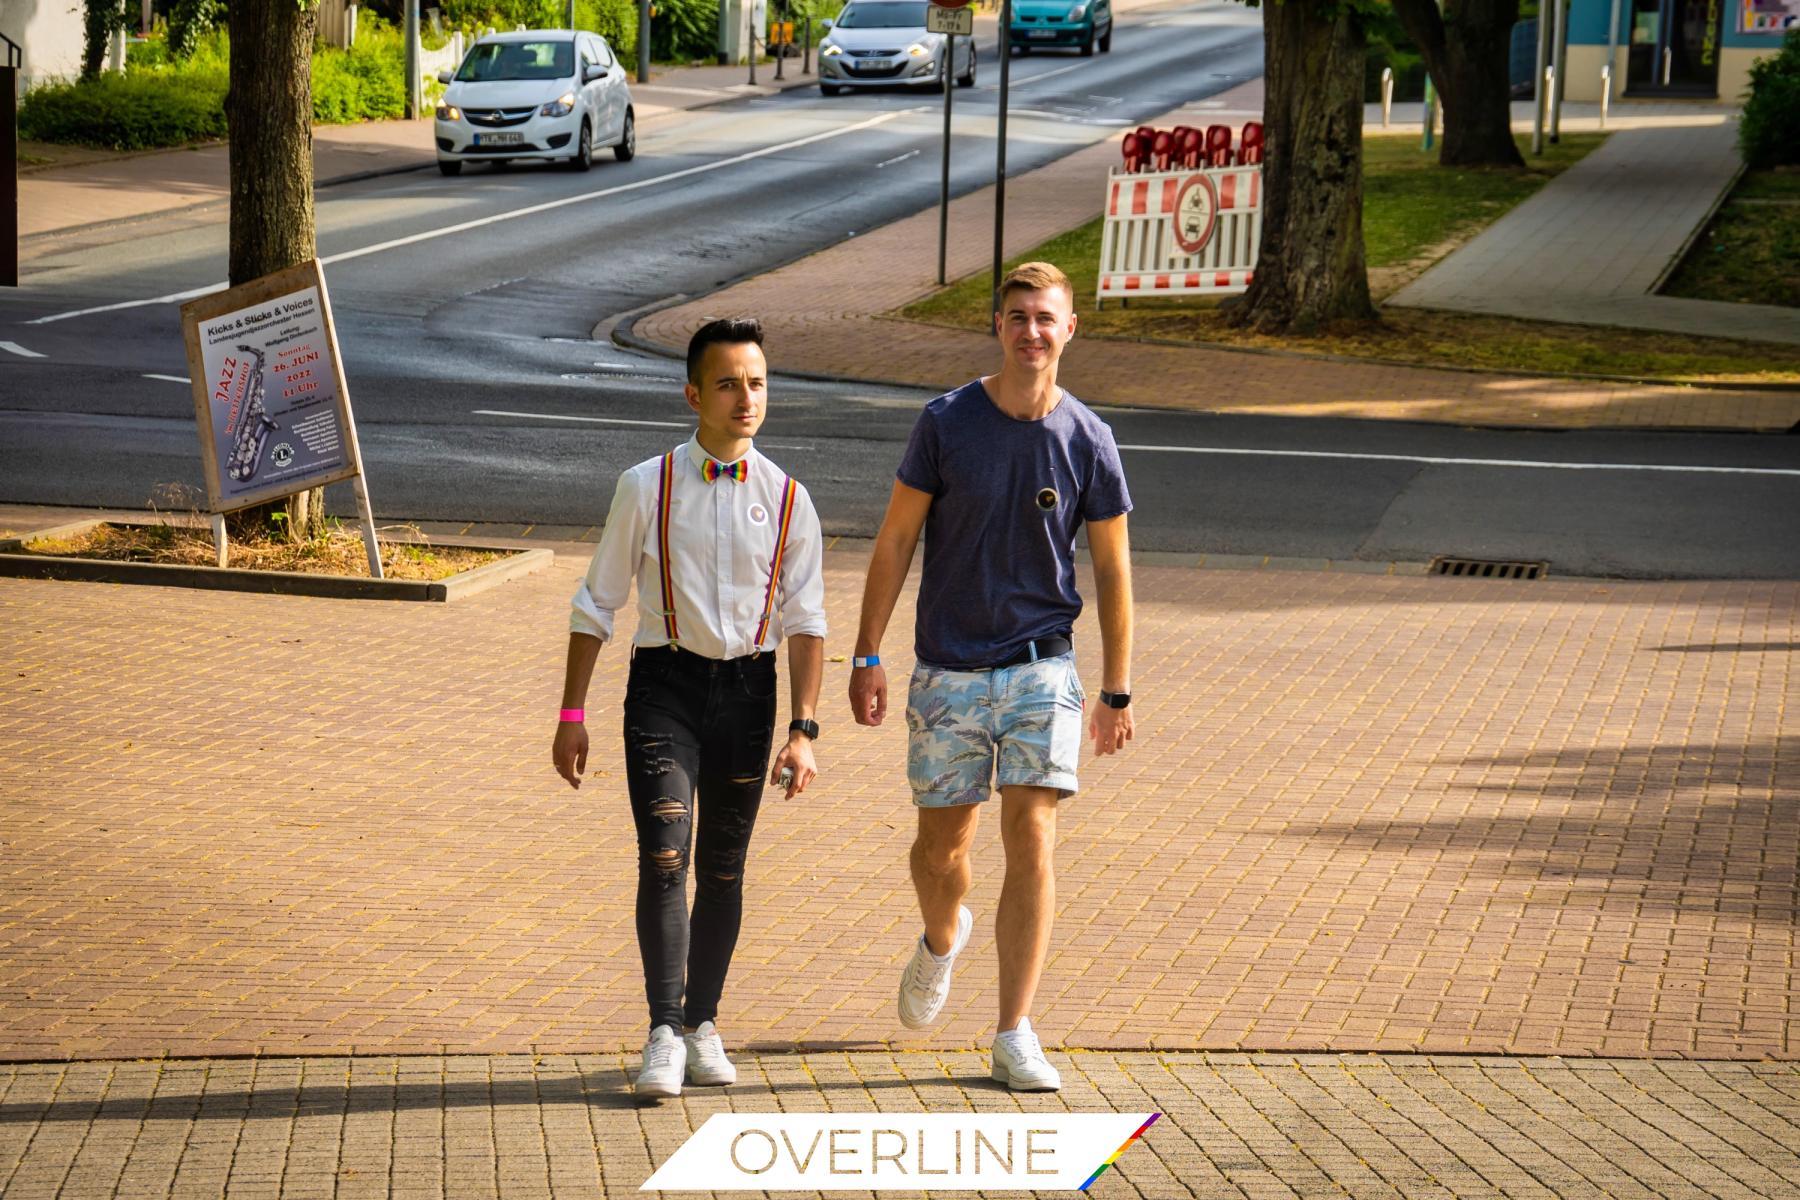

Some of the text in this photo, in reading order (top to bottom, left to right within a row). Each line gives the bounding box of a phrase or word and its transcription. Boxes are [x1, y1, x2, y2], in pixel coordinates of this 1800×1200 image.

[207, 298, 313, 337] Kicks & Sticks & Voices
[278, 344, 311, 358] Sonntag
[292, 351, 319, 367] JUNI
[215, 356, 237, 402] JAZZ
[287, 369, 312, 382] 2022
[297, 381, 319, 393] Uhr
